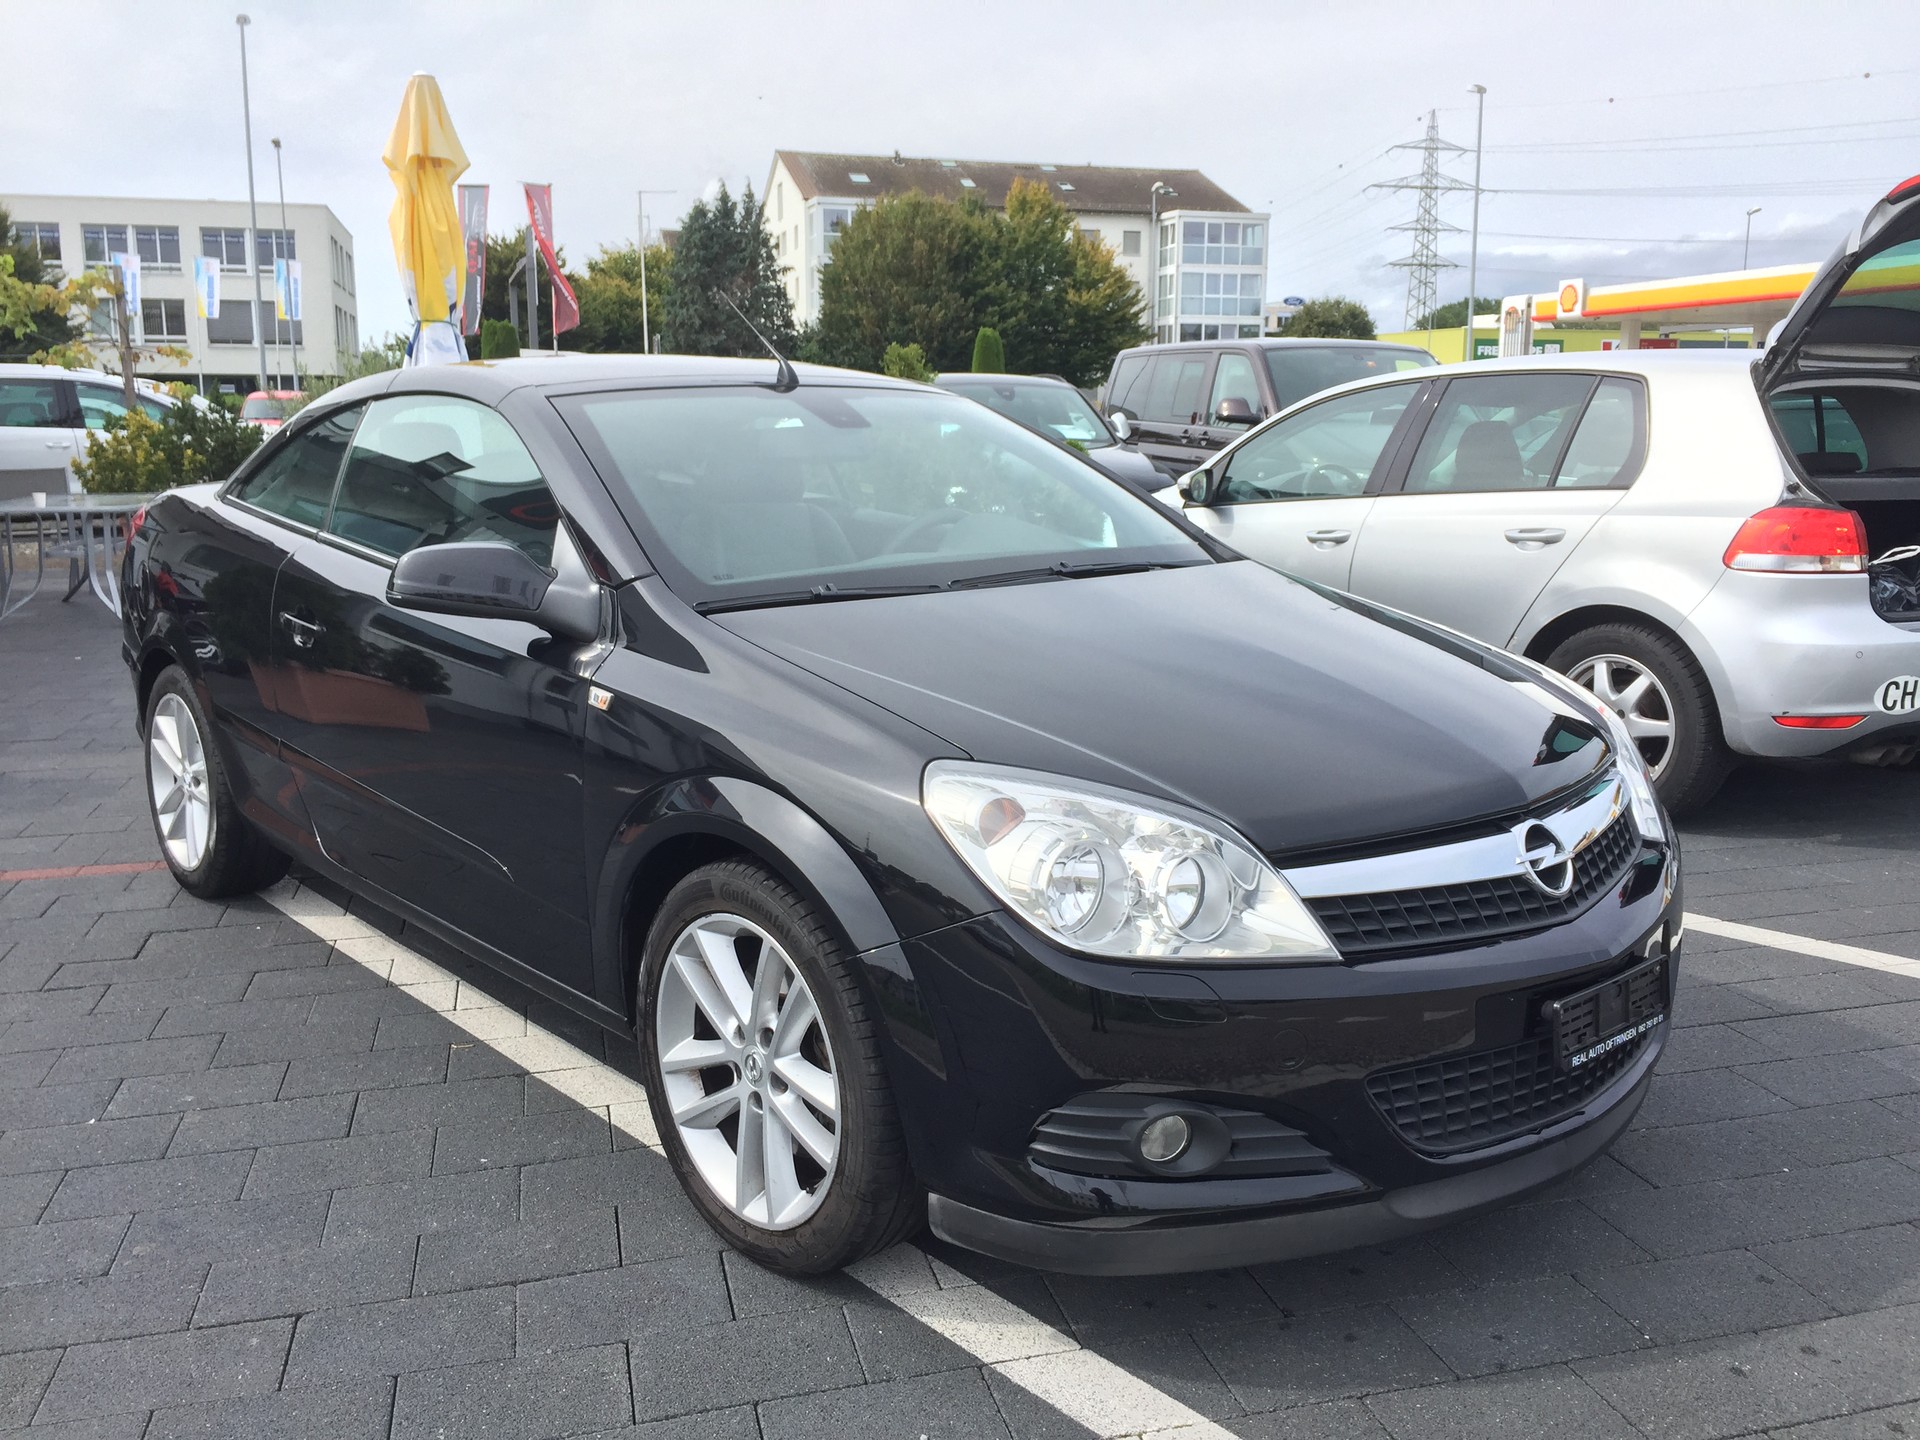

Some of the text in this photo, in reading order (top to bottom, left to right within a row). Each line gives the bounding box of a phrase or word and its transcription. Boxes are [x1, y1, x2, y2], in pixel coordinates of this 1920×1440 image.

[1882, 680, 1919, 711] CH
[720, 881, 792, 941] Continental
[1572, 1052, 1588, 1067] REAL
[1588, 1043, 1605, 1059] AUTO
[1605, 1027, 1637, 1050] OFTRINGEN
